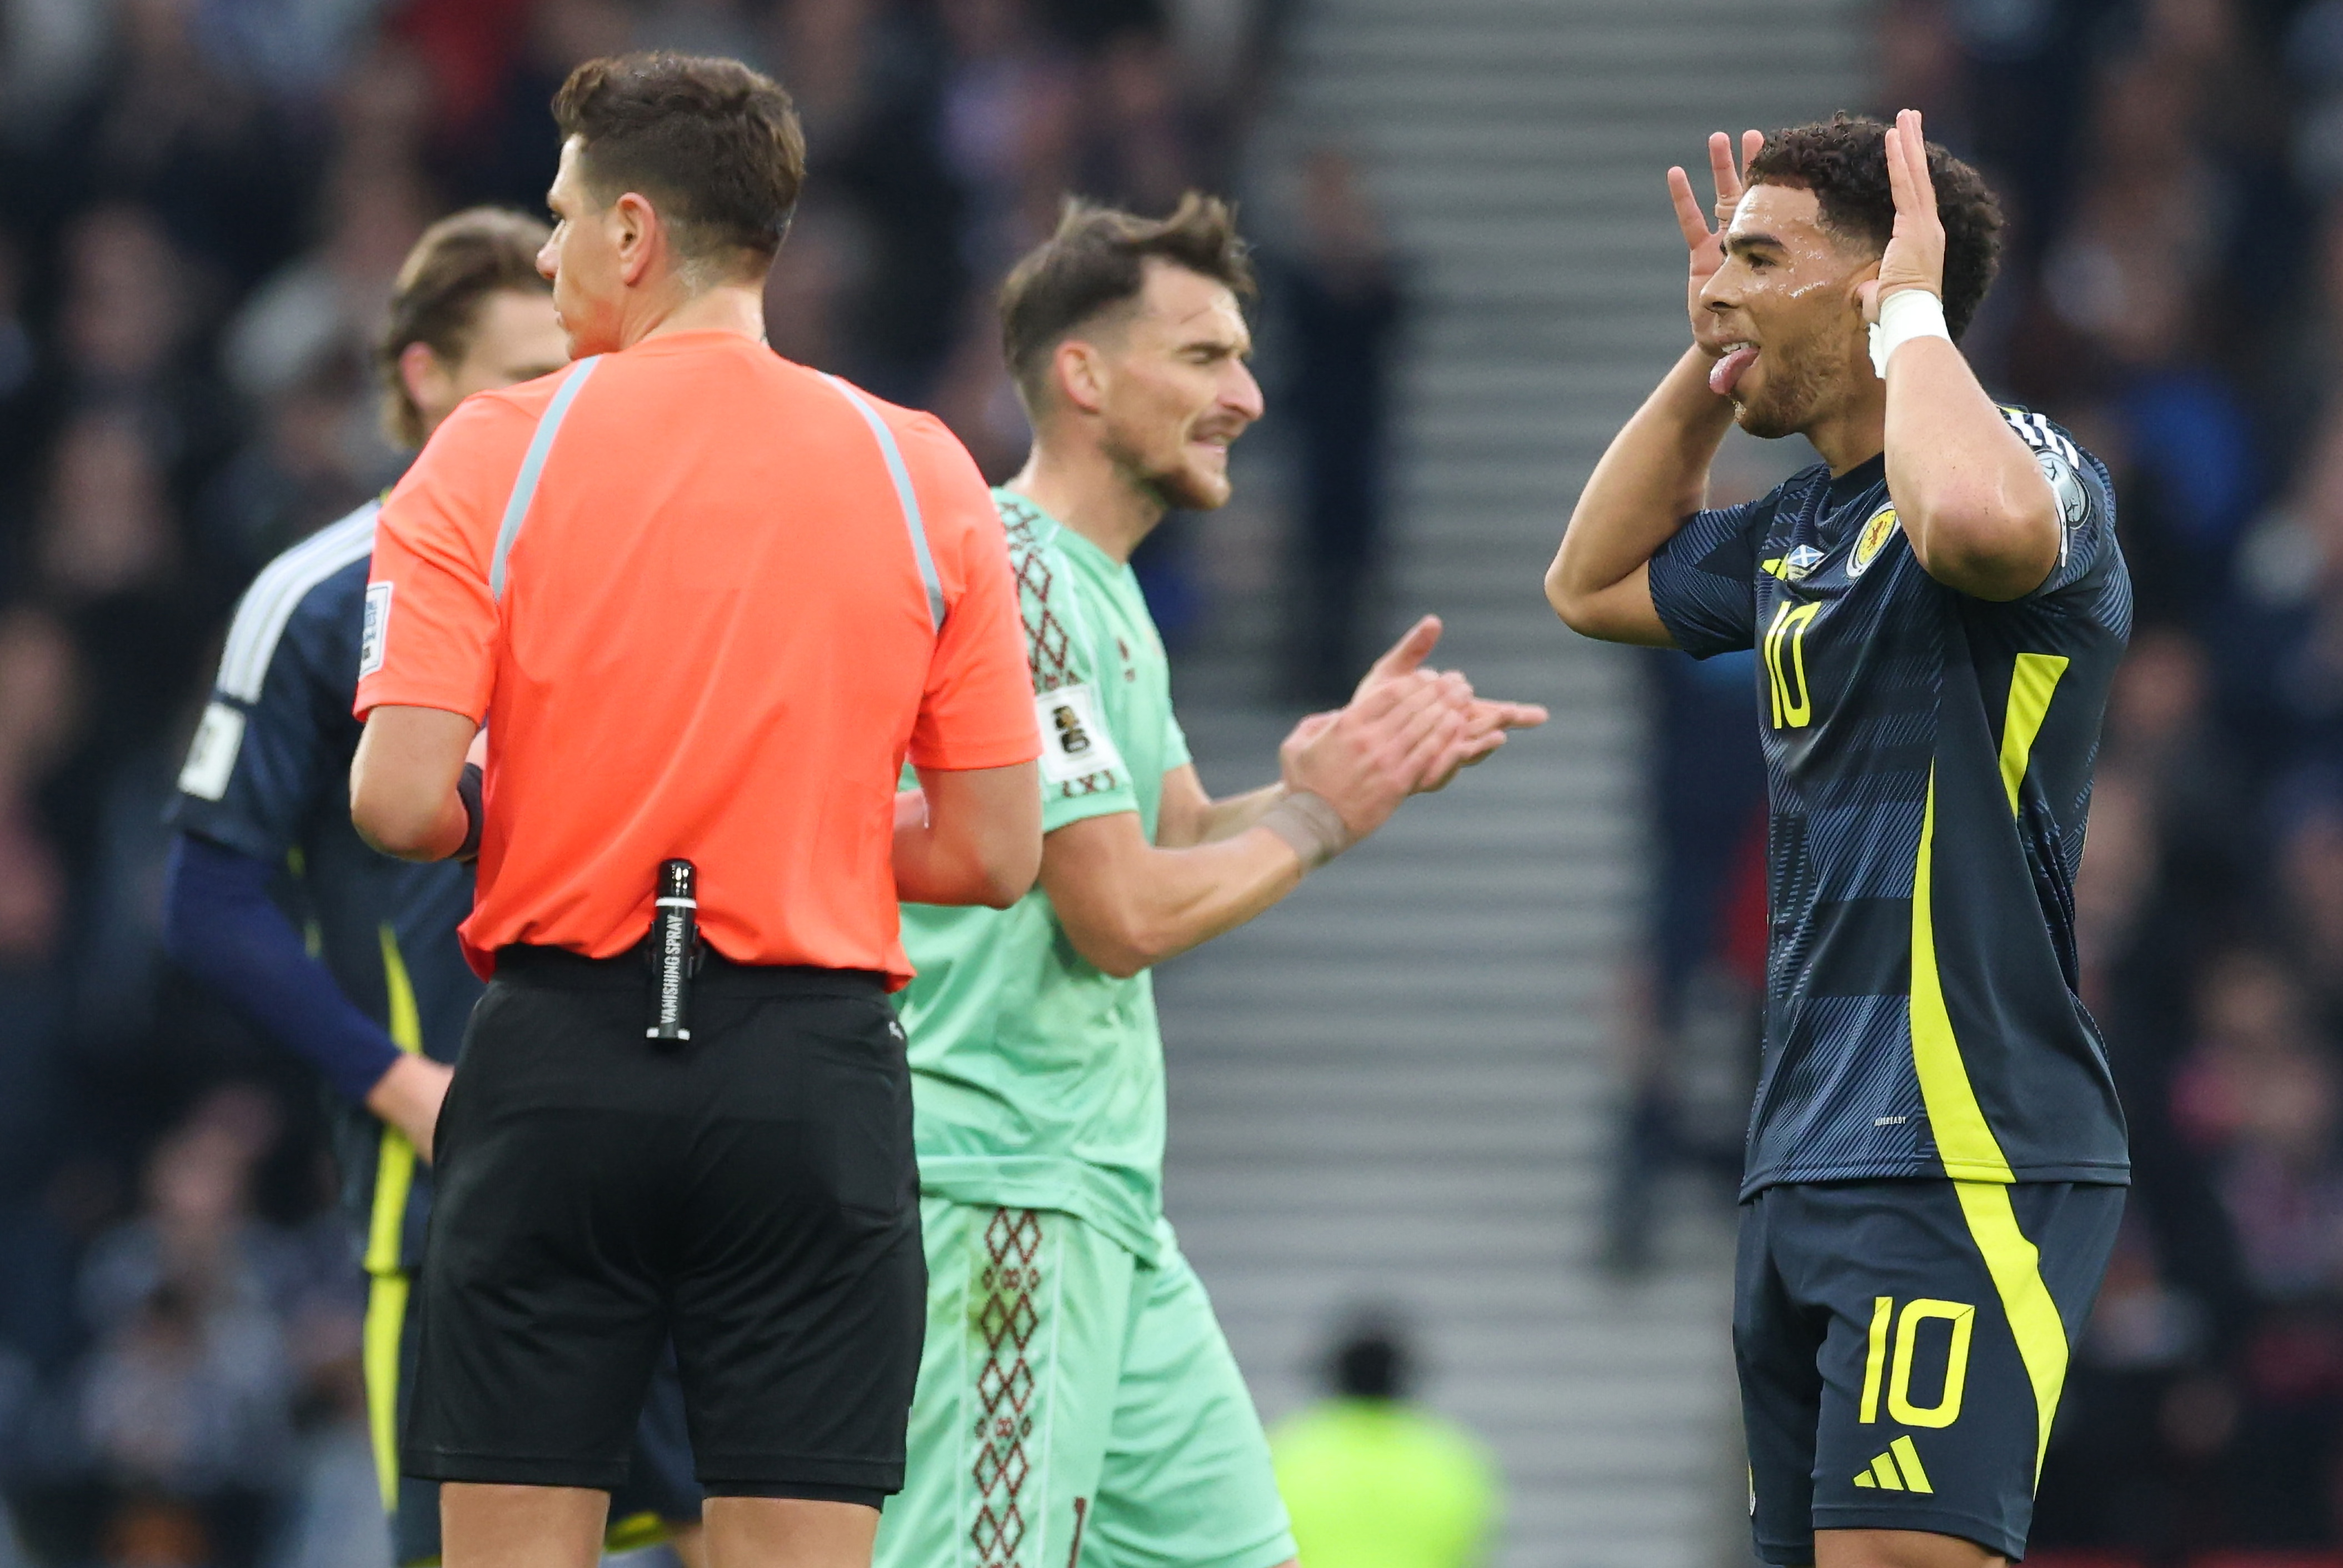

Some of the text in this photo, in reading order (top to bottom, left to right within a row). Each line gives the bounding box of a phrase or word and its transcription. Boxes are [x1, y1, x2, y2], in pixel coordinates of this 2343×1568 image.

[1765, 601, 1821, 729] 10
[661, 914, 682, 1024] VANISHING SPRAY
[1860, 1296, 1975, 1429] 10
